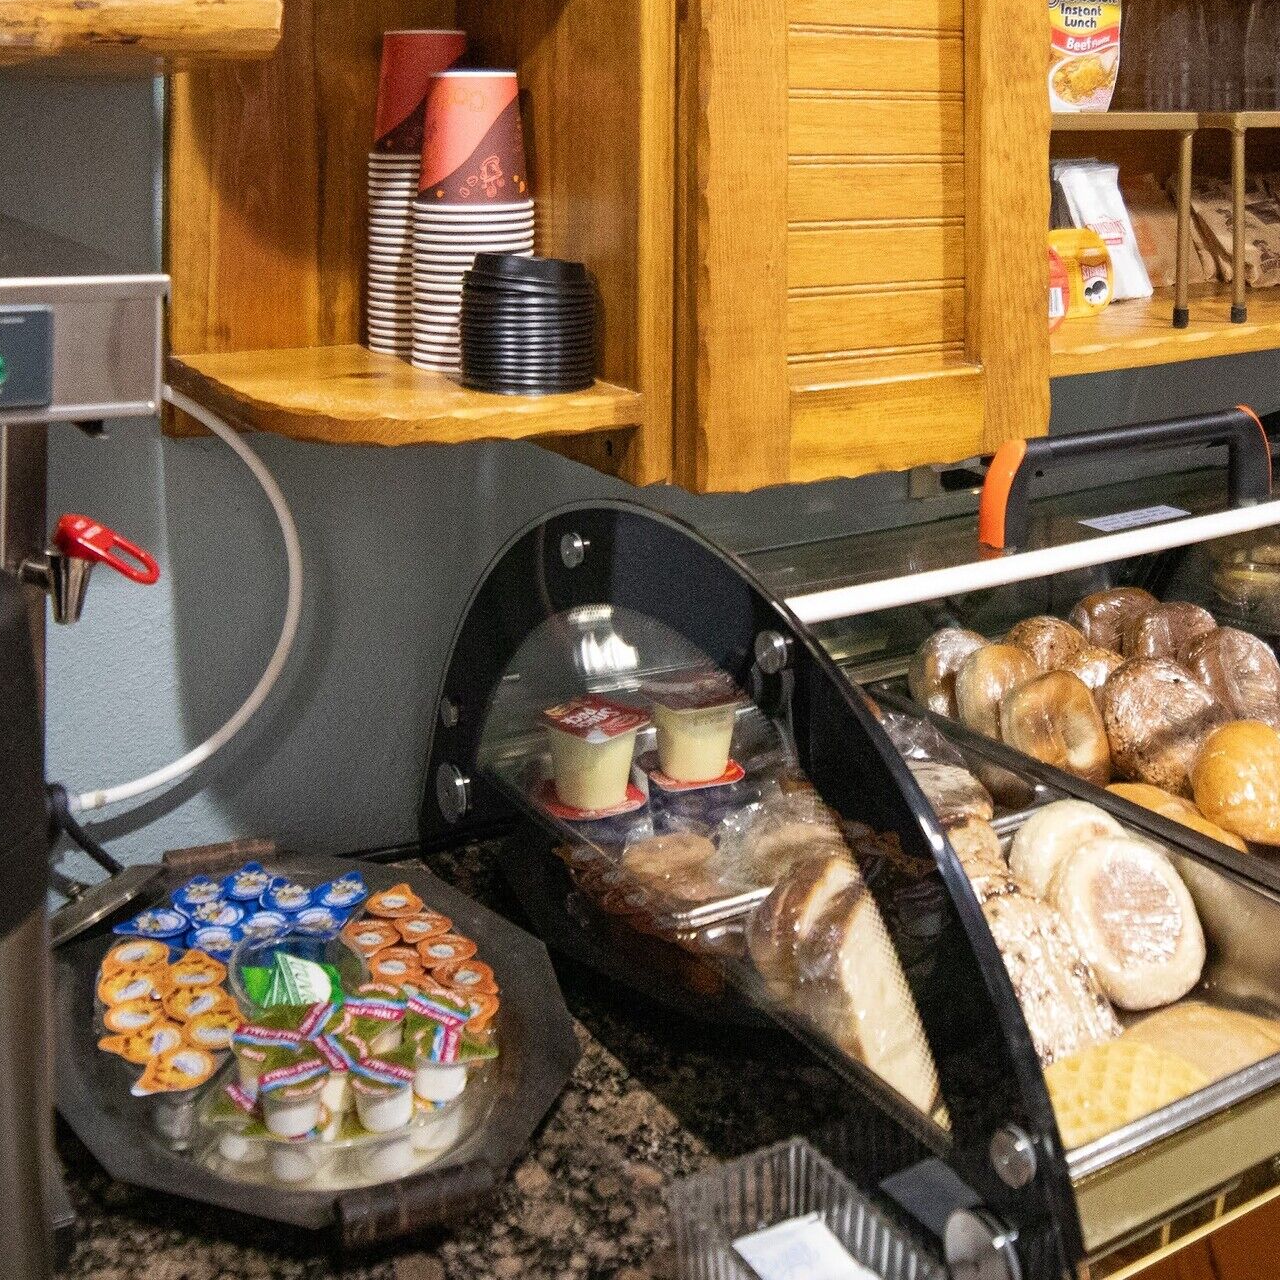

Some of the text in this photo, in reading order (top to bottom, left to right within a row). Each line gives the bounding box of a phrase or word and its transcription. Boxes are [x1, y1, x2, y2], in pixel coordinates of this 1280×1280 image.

[1060, 2, 1102, 16] Instant
[1064, 16, 1097, 29] Lunch
[1066, 36, 1092, 51] Beef
